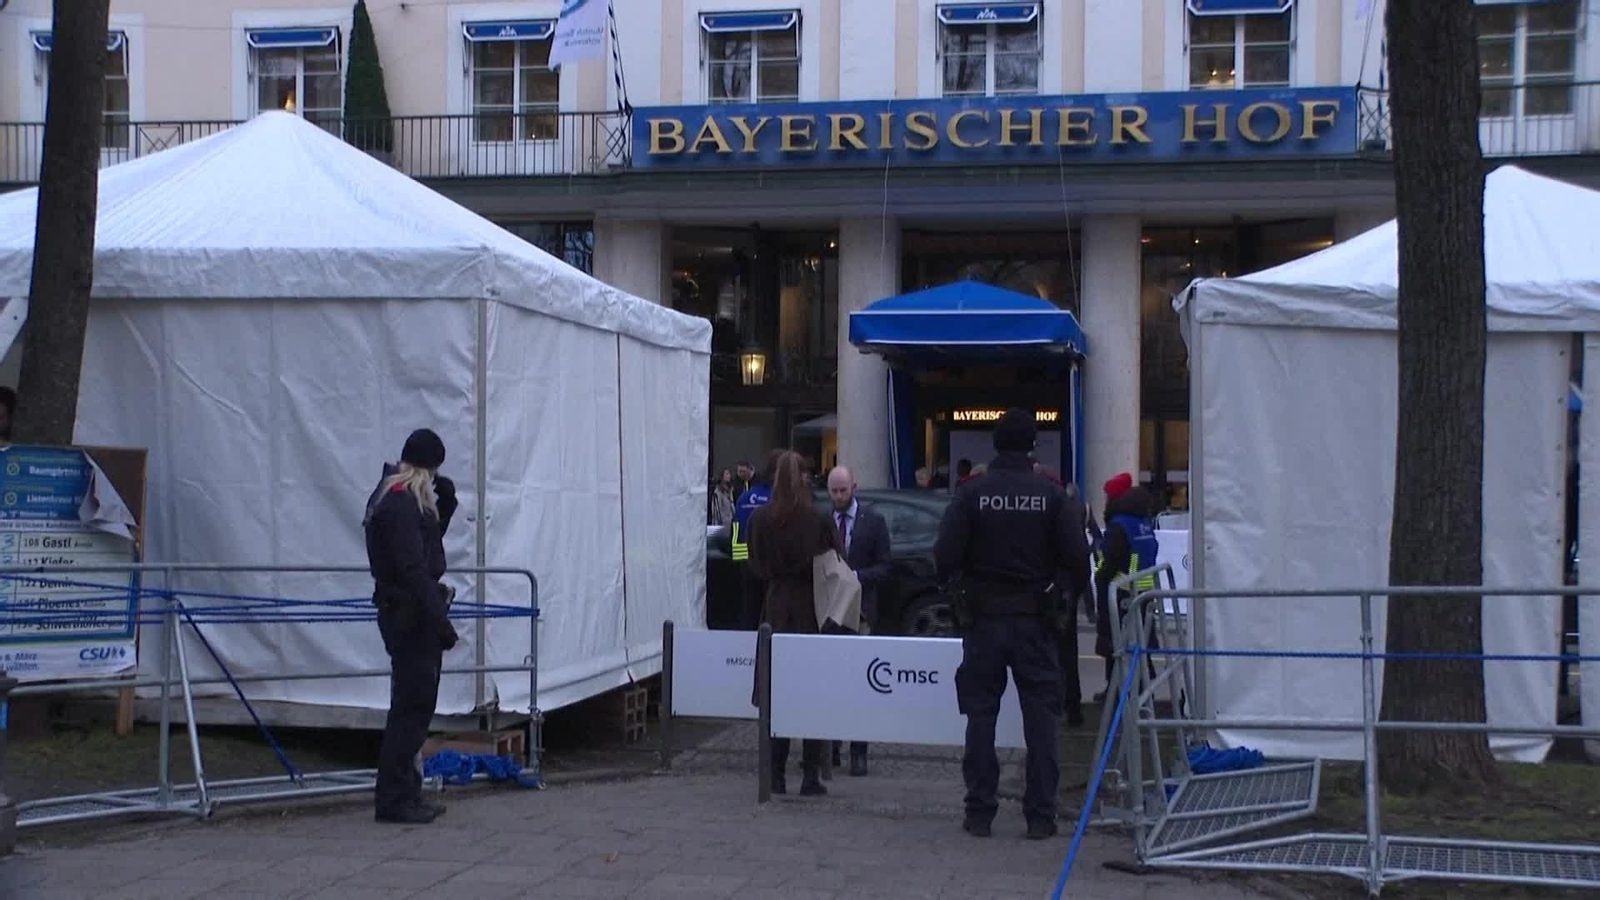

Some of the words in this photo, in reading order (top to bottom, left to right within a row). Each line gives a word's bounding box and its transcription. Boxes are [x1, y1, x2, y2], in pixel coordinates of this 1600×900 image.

[647, 104, 1154, 155] BAYERISCHER
[1182, 99, 1341, 143] HOF
[953, 410, 1007, 420] BAYERISC
[1036, 410, 1058, 421] HOF
[979, 495, 1047, 511] POLIZEI
[43, 536, 72, 547] Gastl
[79, 646, 111, 660] CSU
[897, 667, 939, 684] msc
